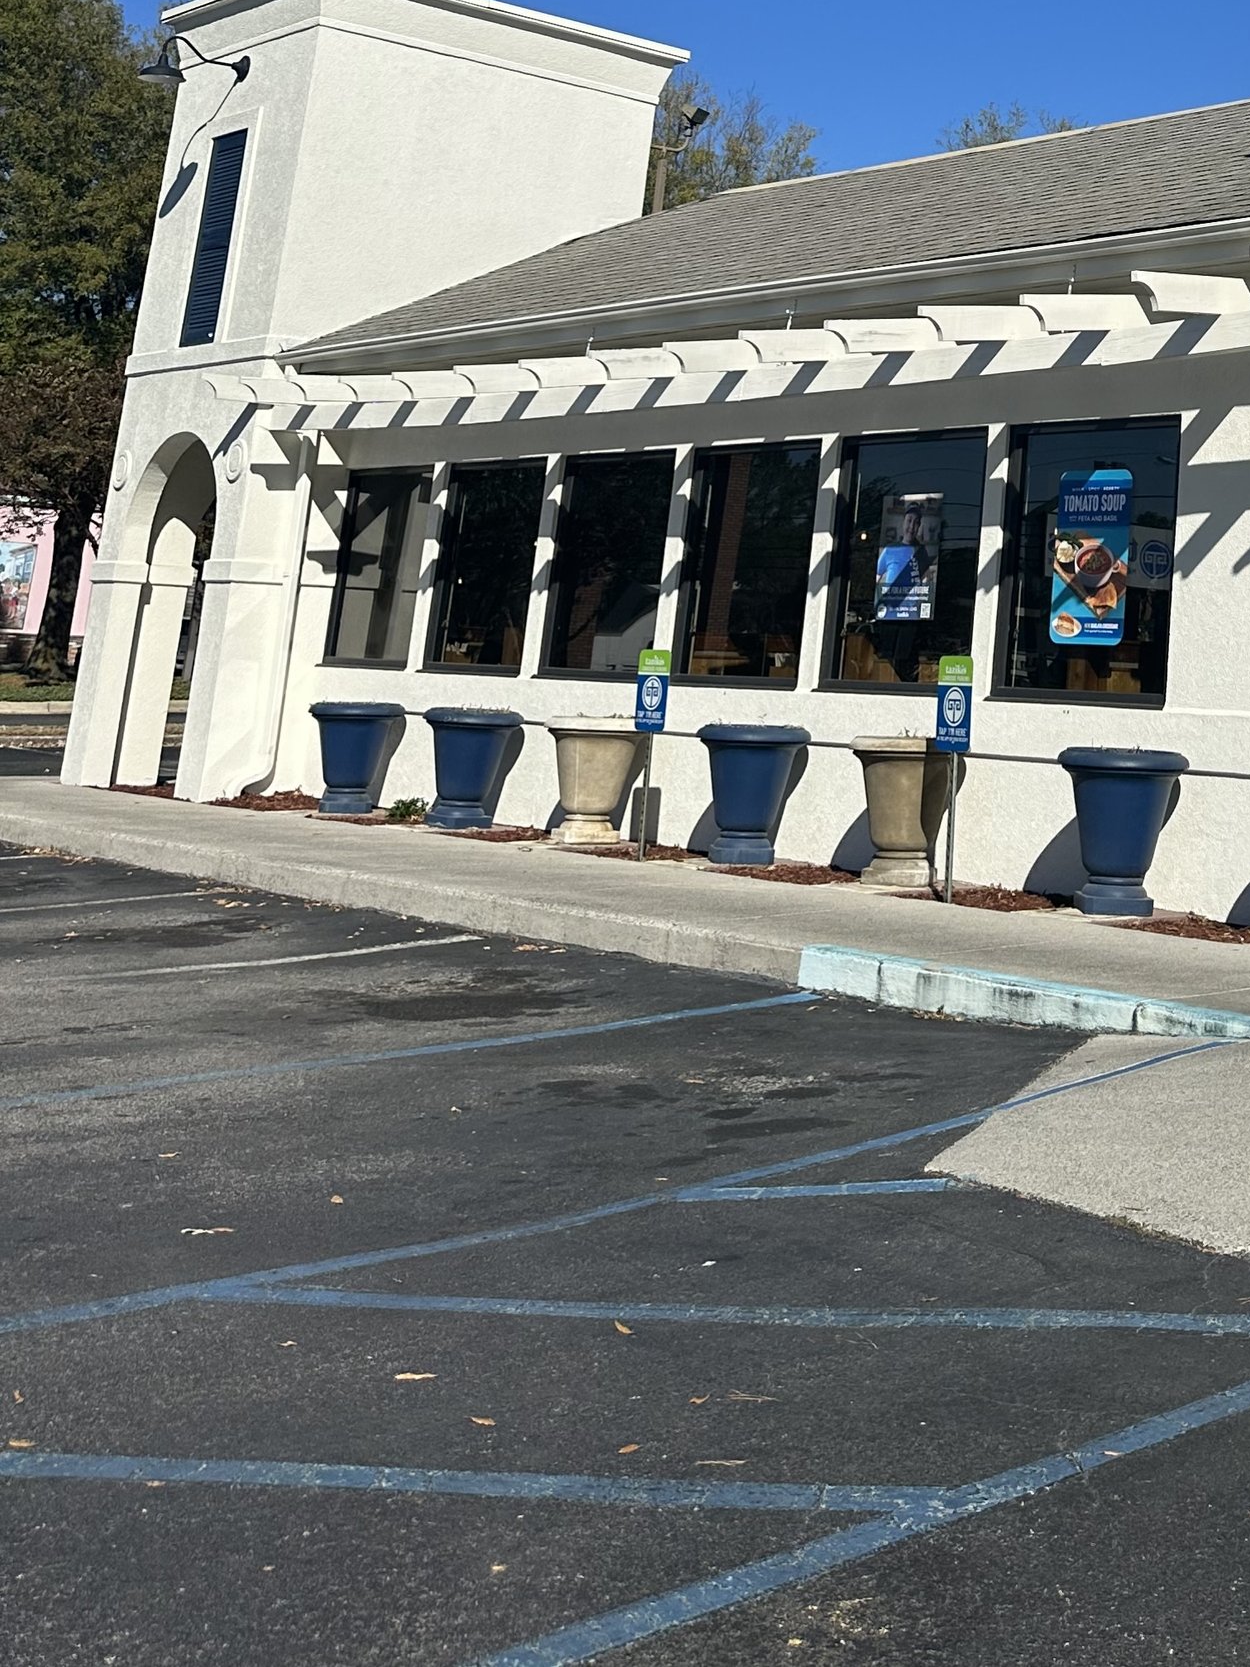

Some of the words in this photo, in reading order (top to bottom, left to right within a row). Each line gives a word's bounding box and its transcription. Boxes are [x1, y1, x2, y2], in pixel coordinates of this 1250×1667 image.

[1064, 494, 1099, 512] TOMATO
[1101, 494, 1126, 512] SOUP
[1077, 515, 1091, 523] FETA
